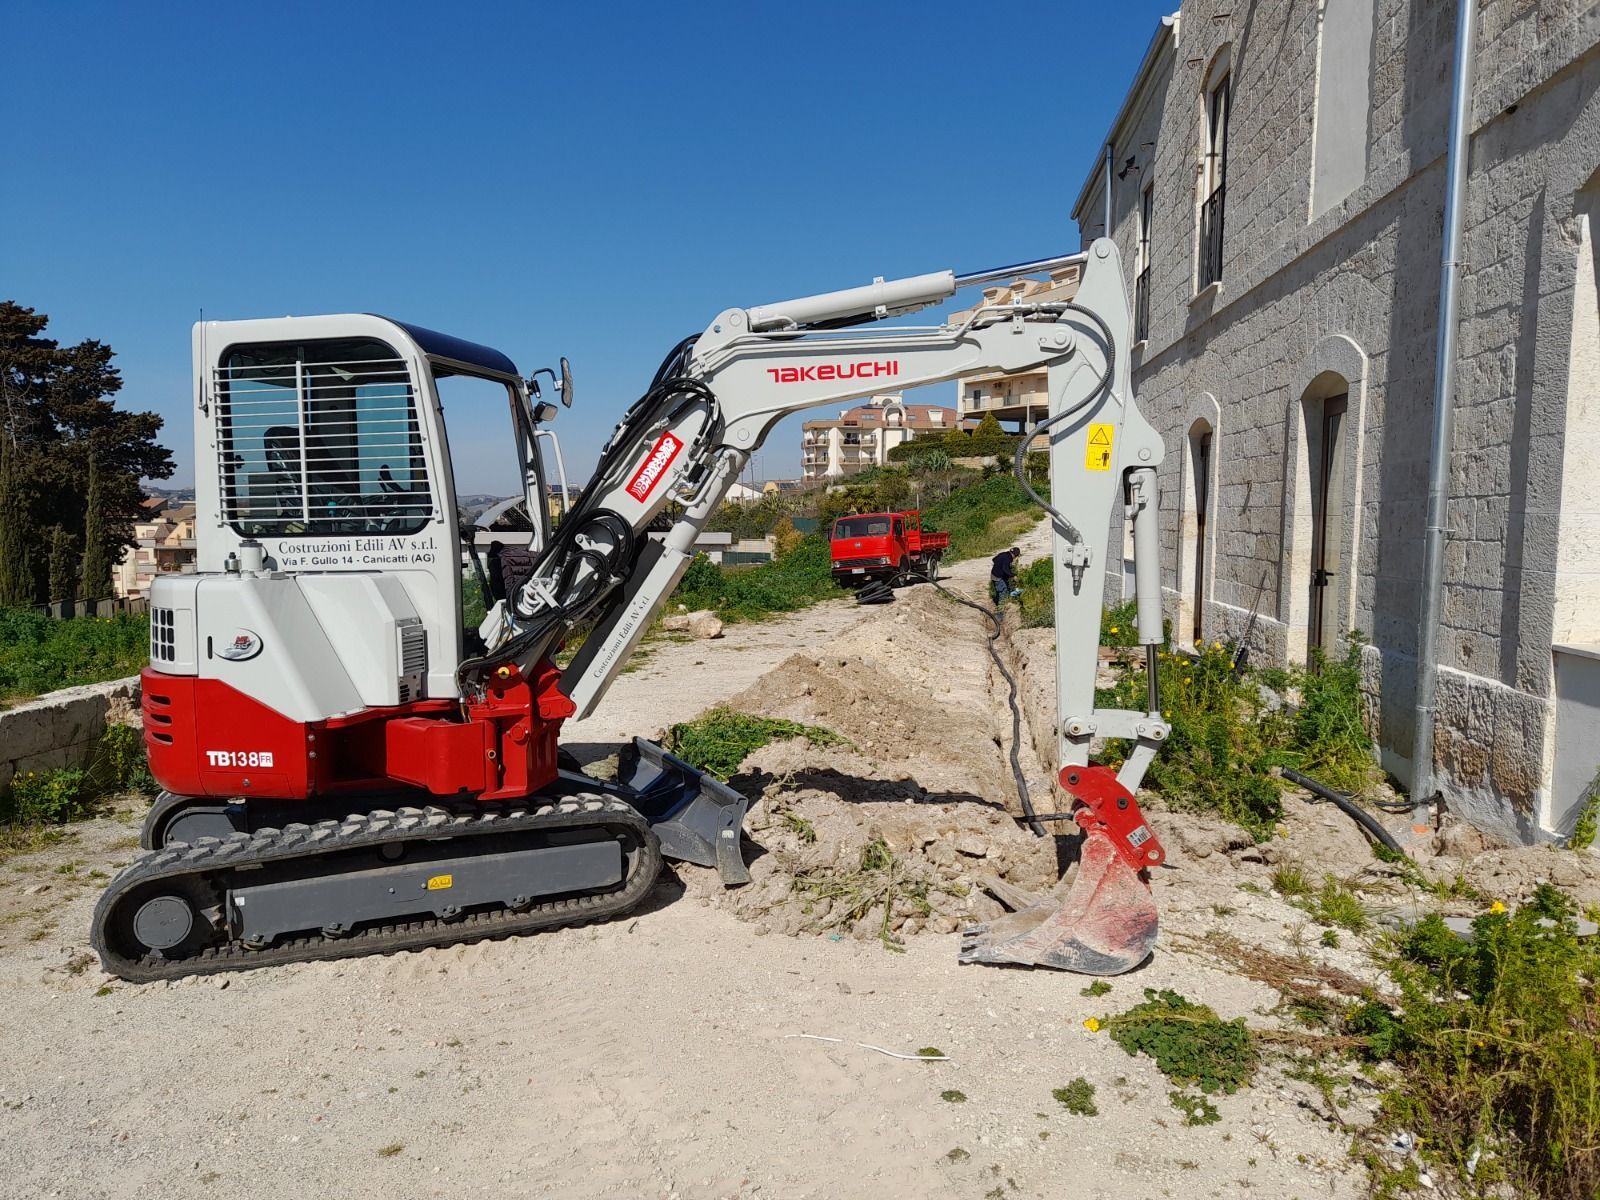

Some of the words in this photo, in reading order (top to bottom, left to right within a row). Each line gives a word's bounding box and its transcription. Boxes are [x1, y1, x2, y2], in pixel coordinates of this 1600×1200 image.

[767, 360, 898, 383] TAKEUCHI
[279, 540, 351, 554] Costruzioni
[355, 539, 384, 551] Edili
[388, 538, 406, 550] AV
[411, 537, 438, 550] s.r.l.
[282, 557, 298, 566] Via
[301, 557, 309, 565] F.
[311, 556, 339, 565] Gullo
[342, 556, 353, 564] 14
[411, 553, 435, 564] (AG)
[593, 639, 623, 678] Costruzioni
[619, 621, 633, 639] Edili
[630, 609, 640, 622] AV
[206, 751, 259, 767] TB138
